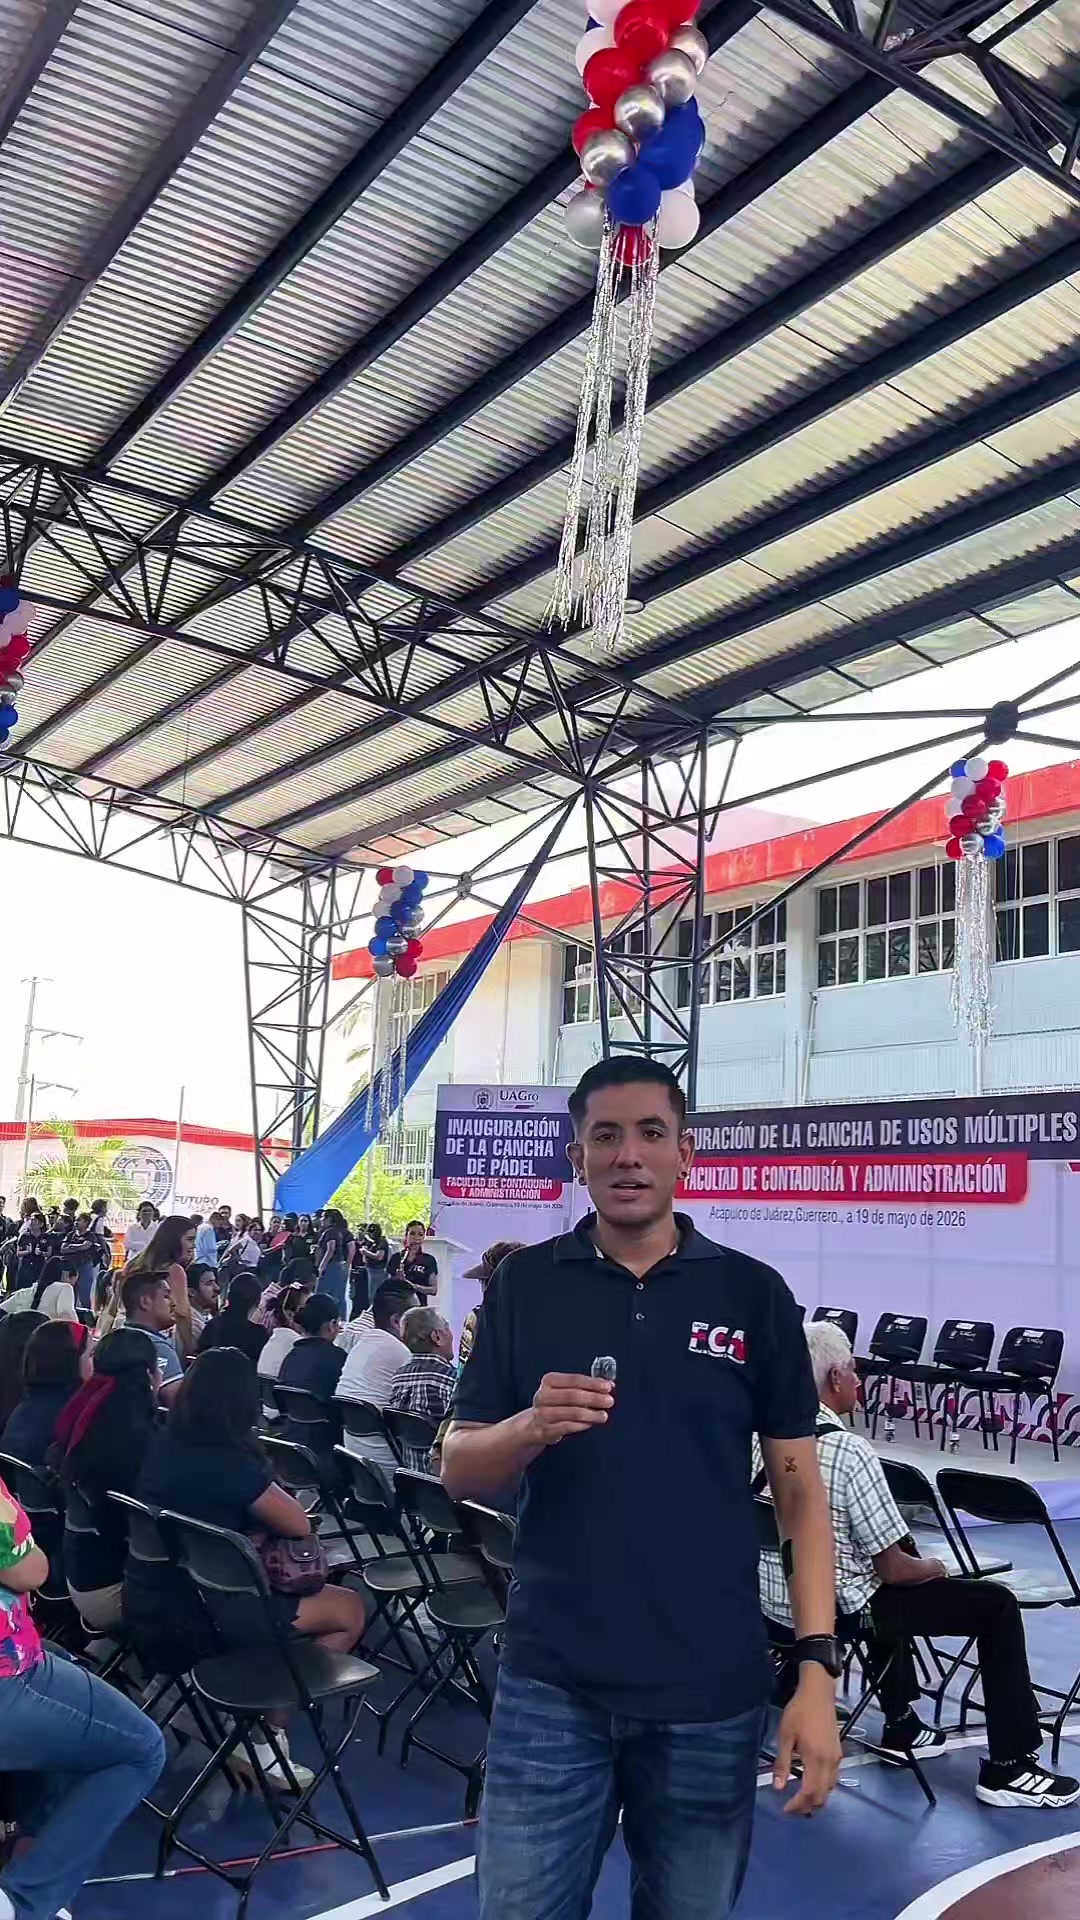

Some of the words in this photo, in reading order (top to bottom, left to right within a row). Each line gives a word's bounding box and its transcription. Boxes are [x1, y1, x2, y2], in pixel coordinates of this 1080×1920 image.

[500, 1090, 539, 1101] UAGro
[447, 1116, 560, 1138] INAUGURACIÓN
[760, 1125, 778, 1149] DE
[783, 1123, 801, 1148] LA
[807, 1120, 874, 1148] CANCHA
[880, 1119, 902, 1146] DE
[908, 1116, 958, 1145] USOS
[965, 1109, 1078, 1144] MÚLTIPLES
[445, 1138, 465, 1155] DE
[469, 1138, 487, 1156] LA
[492, 1139, 554, 1157] CANCHA
[467, 1158, 486, 1175] DE
[490, 1155, 537, 1177] PÁDEL
[742, 1166, 758, 1191] DE
[761, 1160, 845, 1192] CONTADURÍA
[850, 1165, 859, 1192] Y
[864, 1157, 1007, 1193] ADMINISTRACIÓN
[446, 1176, 486, 1188] FACULTAD
[487, 1178, 499, 1189] DE
[500, 1177, 553, 1190] CONTADURÍA
[460, 1187, 467, 1197] Y
[469, 1187, 541, 1199] ADMINISTRACIÓN
[710, 1205, 749, 1222] Acapulco
[750, 1207, 761, 1220] de
[847, 1212, 853, 1224] a
[856, 1208, 869, 1224] 19
[872, 1209, 884, 1224] de
[887, 1211, 917, 1228] mayo
[920, 1210, 933, 1225] de
[937, 1210, 966, 1227] 2026
[689, 1321, 745, 1361] FCA
